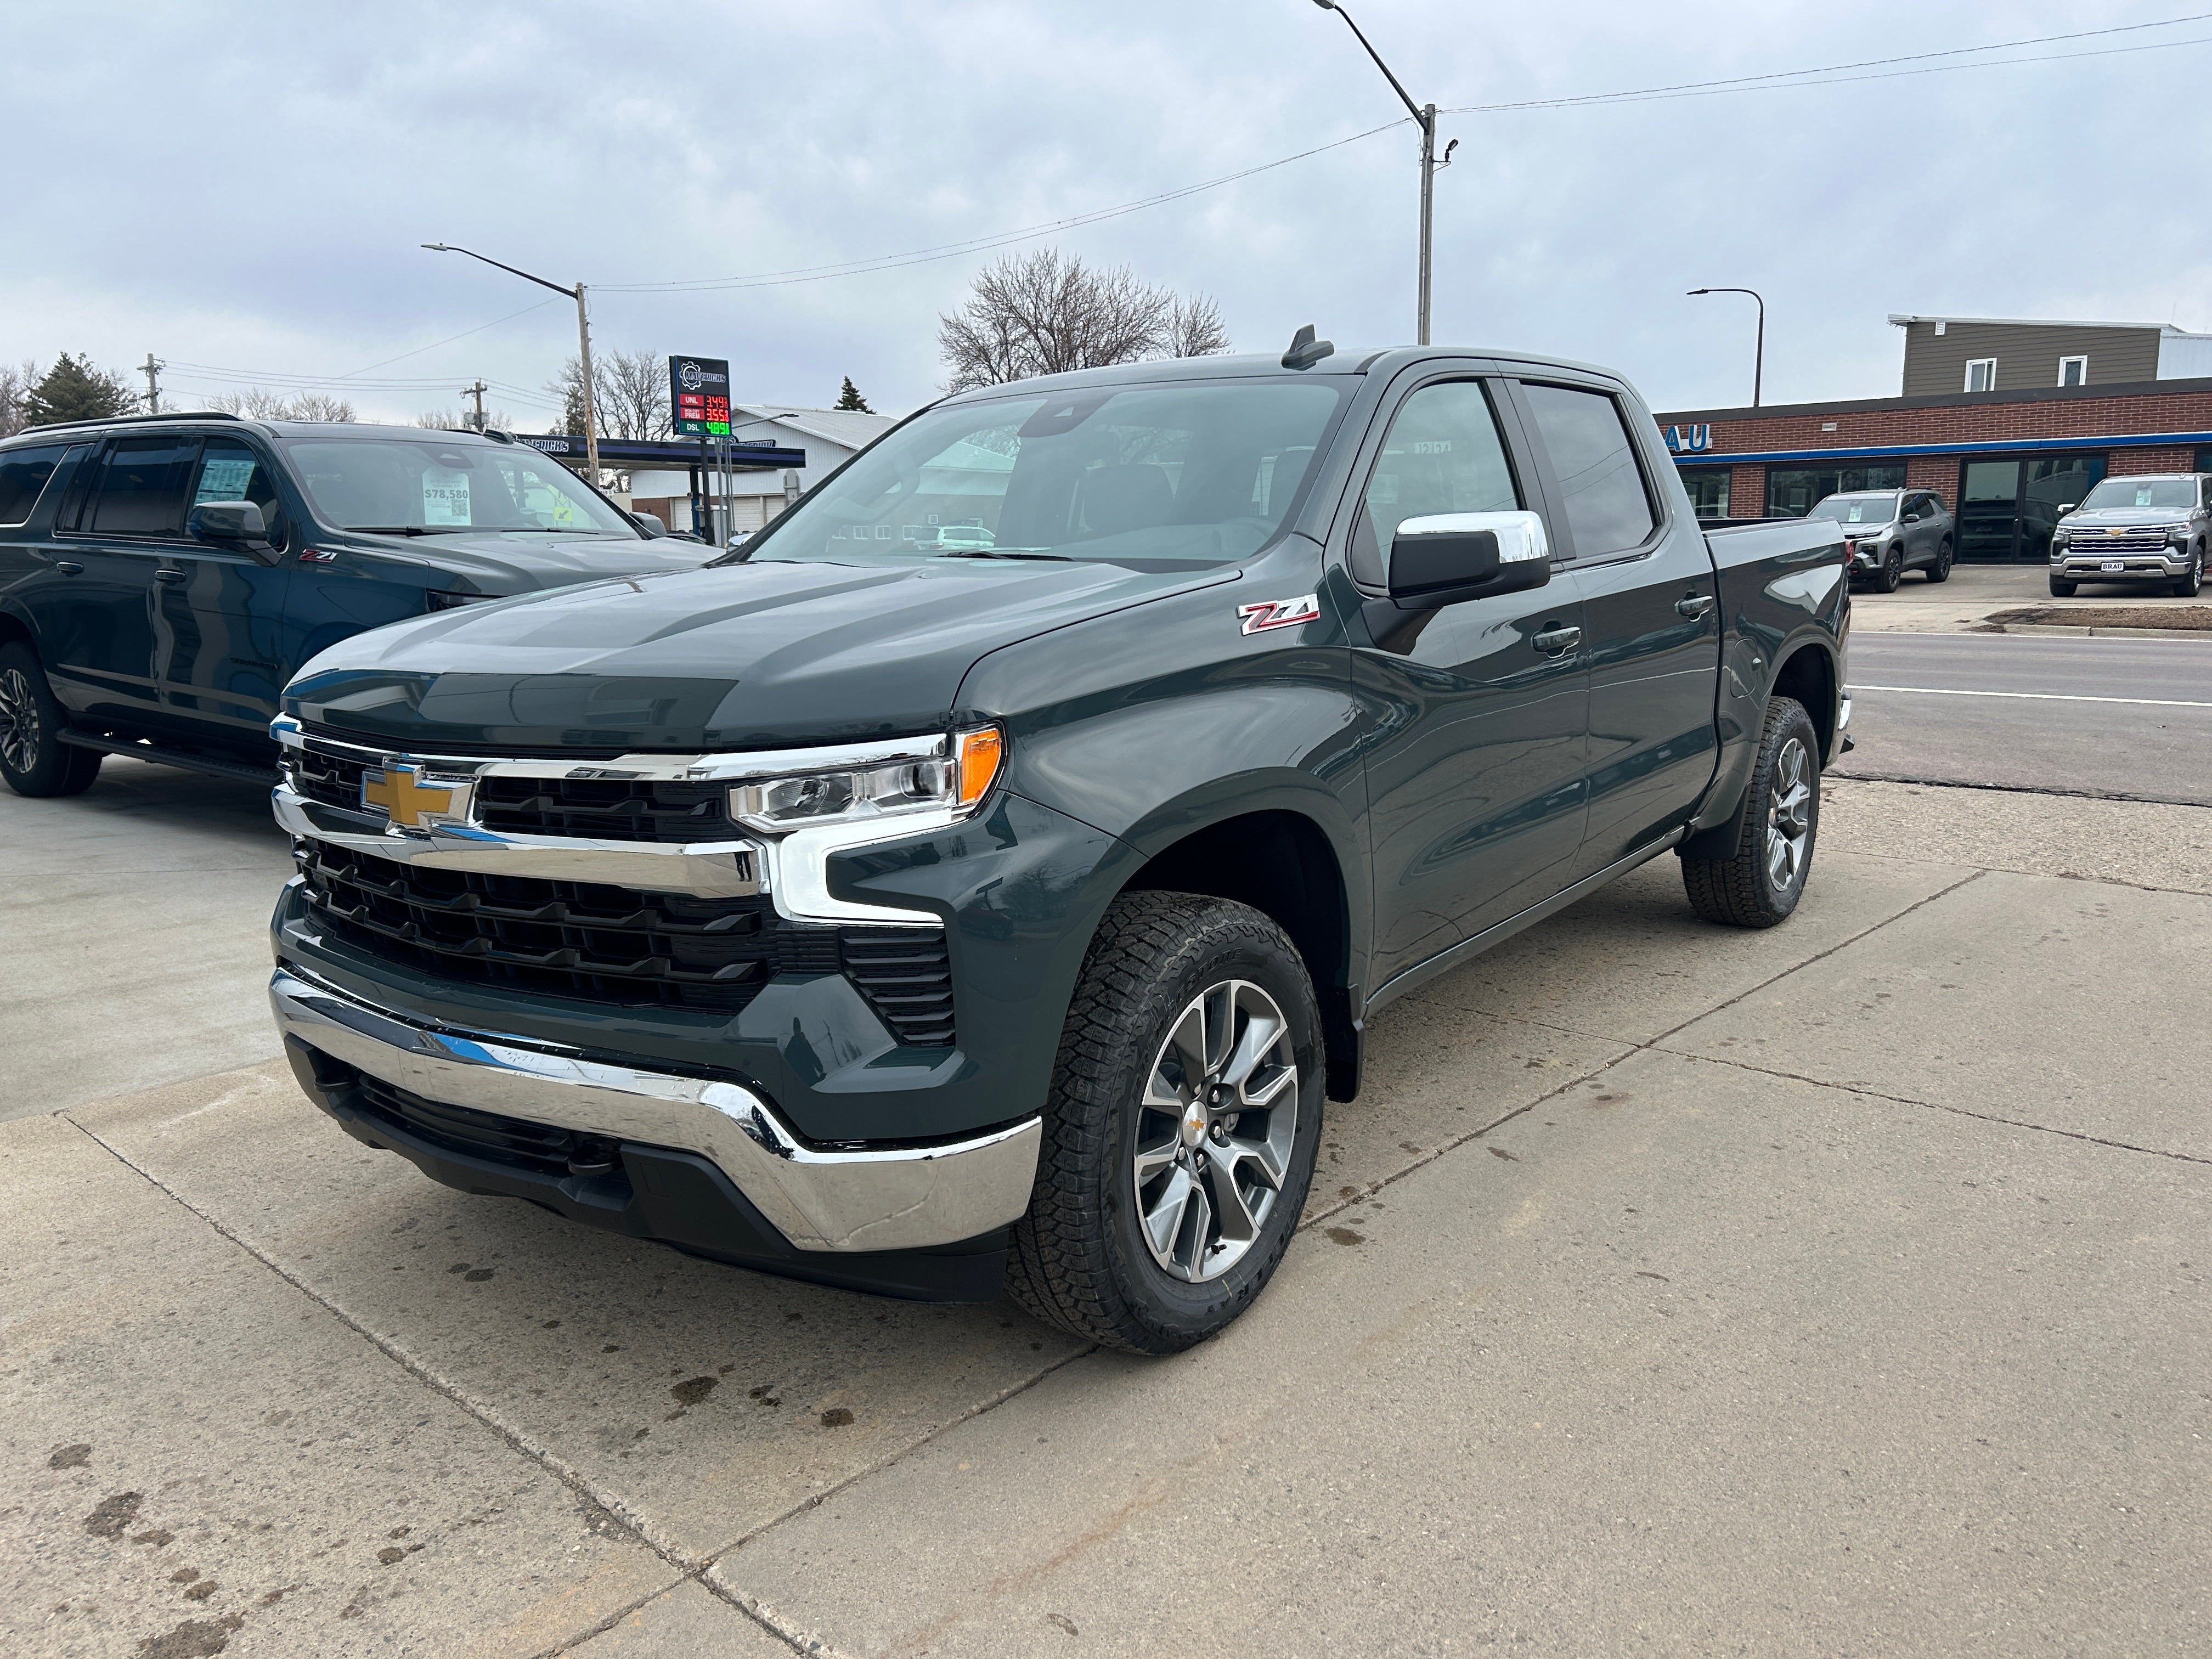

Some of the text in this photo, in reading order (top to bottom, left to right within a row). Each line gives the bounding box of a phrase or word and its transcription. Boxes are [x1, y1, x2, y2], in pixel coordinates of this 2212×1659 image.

[687, 423, 699, 431] DSL
[425, 488, 469, 500] $78,580
[299, 549, 338, 563] Z71
[1235, 594, 1320, 636] Z71
